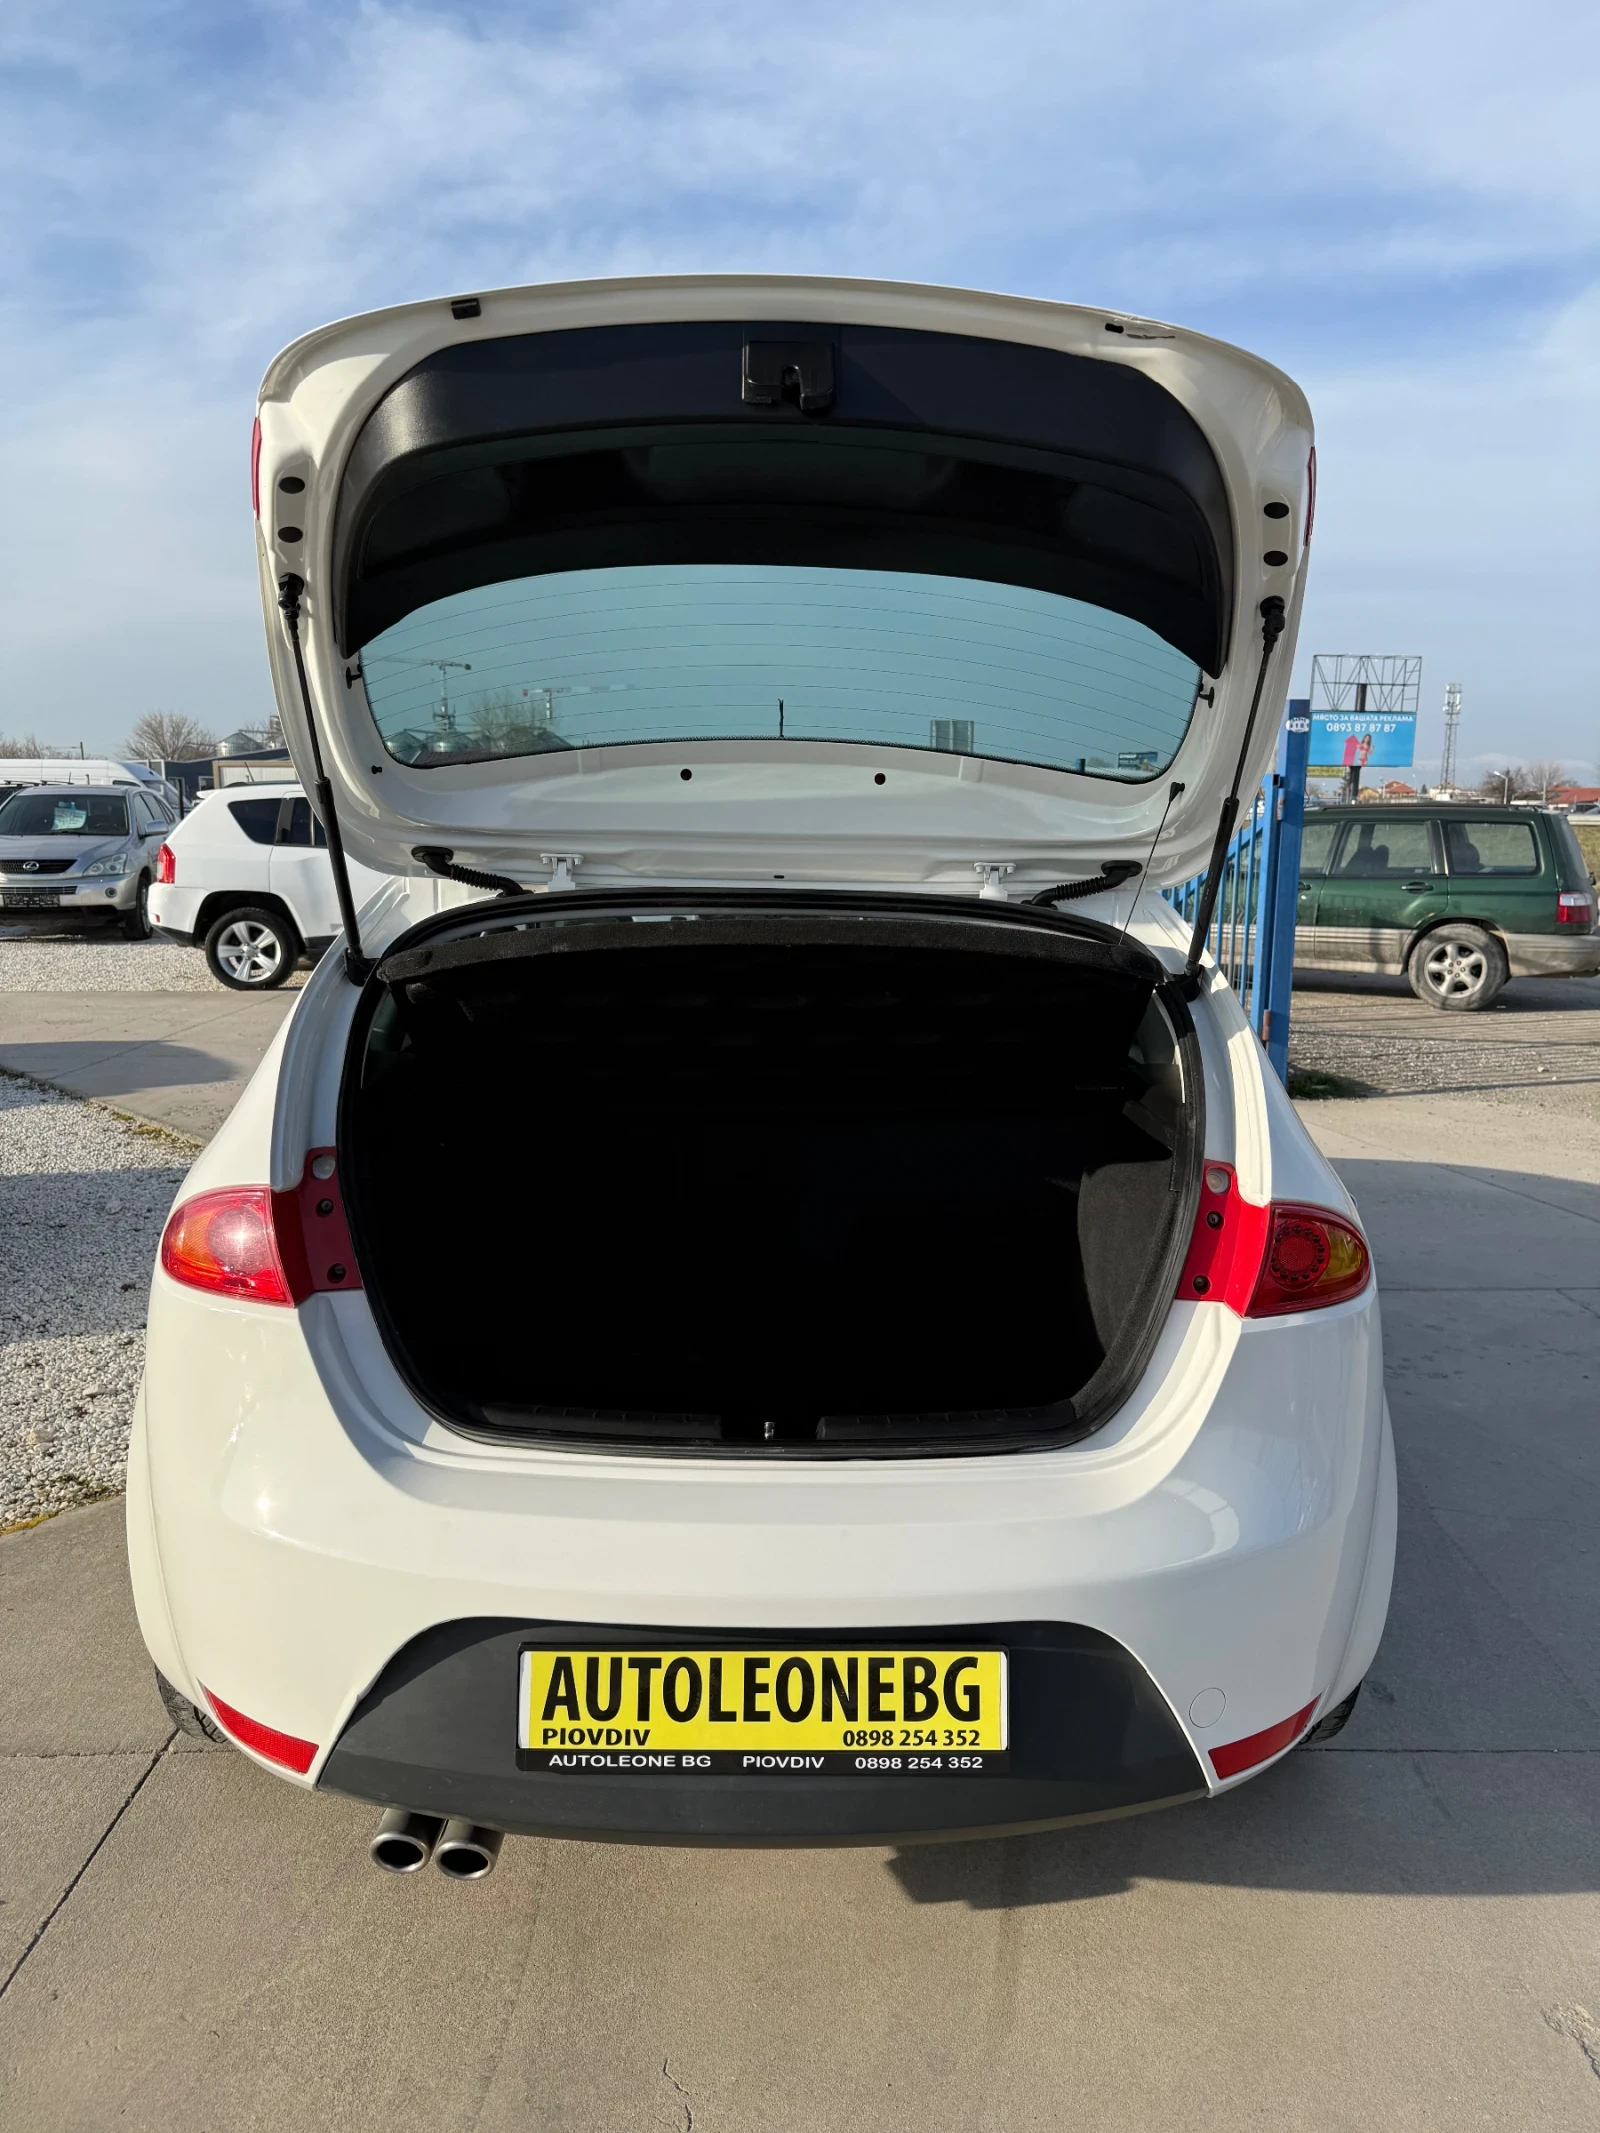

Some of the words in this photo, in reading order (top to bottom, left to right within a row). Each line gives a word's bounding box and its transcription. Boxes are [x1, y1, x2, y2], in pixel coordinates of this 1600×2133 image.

[1312, 714, 1339, 722] МЯСТО
[1340, 714, 1349, 722] ЗА
[1326, 722, 1352, 733] 0893
[1354, 723, 1367, 733] 87
[1369, 723, 1381, 733] 87
[1383, 723, 1396, 733] 87
[541, 1656, 981, 1723] AUTOLEONEBG
[542, 1727, 651, 1746] PIOVDIV
[843, 1729, 894, 1747] 0898
[899, 1729, 938, 1747] 254
[943, 1729, 980, 1747] 352
[549, 1754, 676, 1768] AUTOLEONE
[682, 1754, 712, 1768] BG
[742, 1755, 825, 1769] PIOVDIV
[855, 1756, 902, 1769] 0898
[907, 1756, 943, 1769] 254
[948, 1756, 983, 1769] 352
